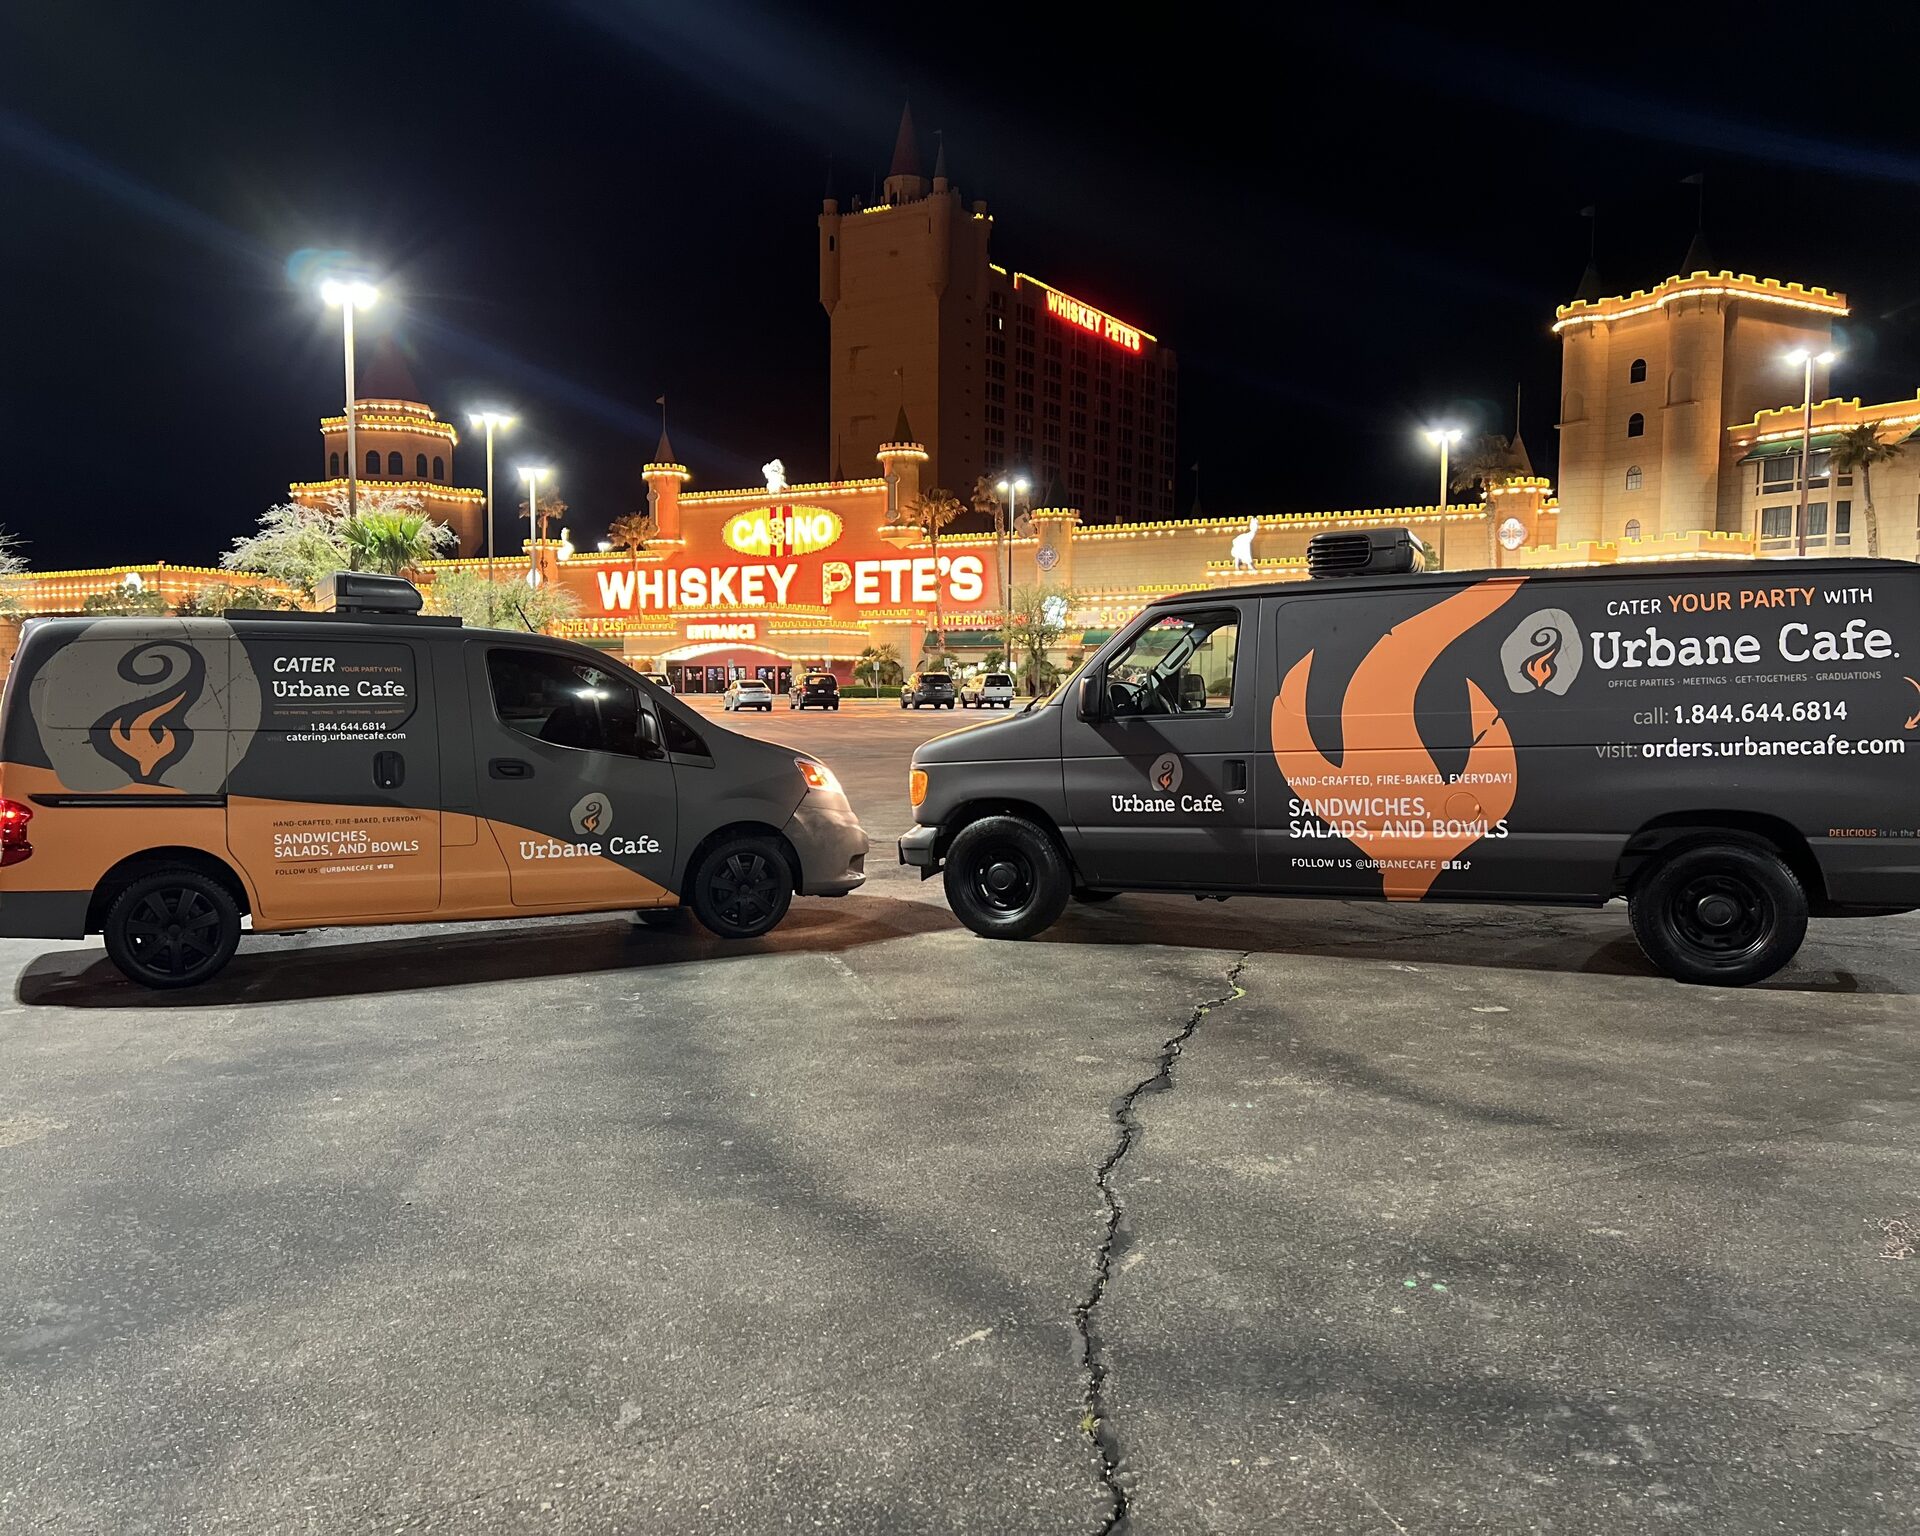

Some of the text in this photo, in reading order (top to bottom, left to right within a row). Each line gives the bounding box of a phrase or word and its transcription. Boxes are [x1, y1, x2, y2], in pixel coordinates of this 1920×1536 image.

[1046, 290, 1101, 333] WHISKEY
[597, 555, 984, 610] WHISKEY PETE'S
[1606, 587, 1873, 616] CATER YOUR PARTY WITH
[686, 623, 756, 640] ENTRANCE
[1590, 626, 1761, 669] Urbane
[273, 657, 336, 673] CATER
[1608, 671, 1882, 688] OFFICE PARTIES MEETINGS GET-TOGETHERS GRADUATIONS
[272, 680, 350, 697] Urbane
[1633, 701, 1848, 725] call: 1.844.644.6814
[310, 723, 386, 731] 1.844.644.6814
[286, 732, 406, 743] catering.urbanecafe.com
[1596, 735, 1906, 759] visit: orders.urbanecafe.com
[1287, 774, 1512, 787] HAND-CRAFTED, FIRE-BAKED, EVERYDAY!
[1111, 794, 1176, 812] Urbane
[1288, 797, 1431, 819] SANDWICHES,
[273, 815, 421, 827] HAND-CRAFTED, FIRE-BAKED, EVERYDAY!
[274, 830, 371, 845] SANDWICHES,
[1289, 820, 1509, 841] SALADS, AND BOWLS
[1829, 828, 1877, 837] DELICIOUS
[1880, 828, 1887, 837] is
[1889, 828, 1898, 837] in
[1900, 828, 1915, 837] the
[274, 840, 419, 858] SALADS, AND BOWLS
[520, 839, 602, 860] Urbane
[320, 864, 374, 874] @URBANECAFE
[1291, 858, 1436, 869] FOLLOW US @URBANECAFE
